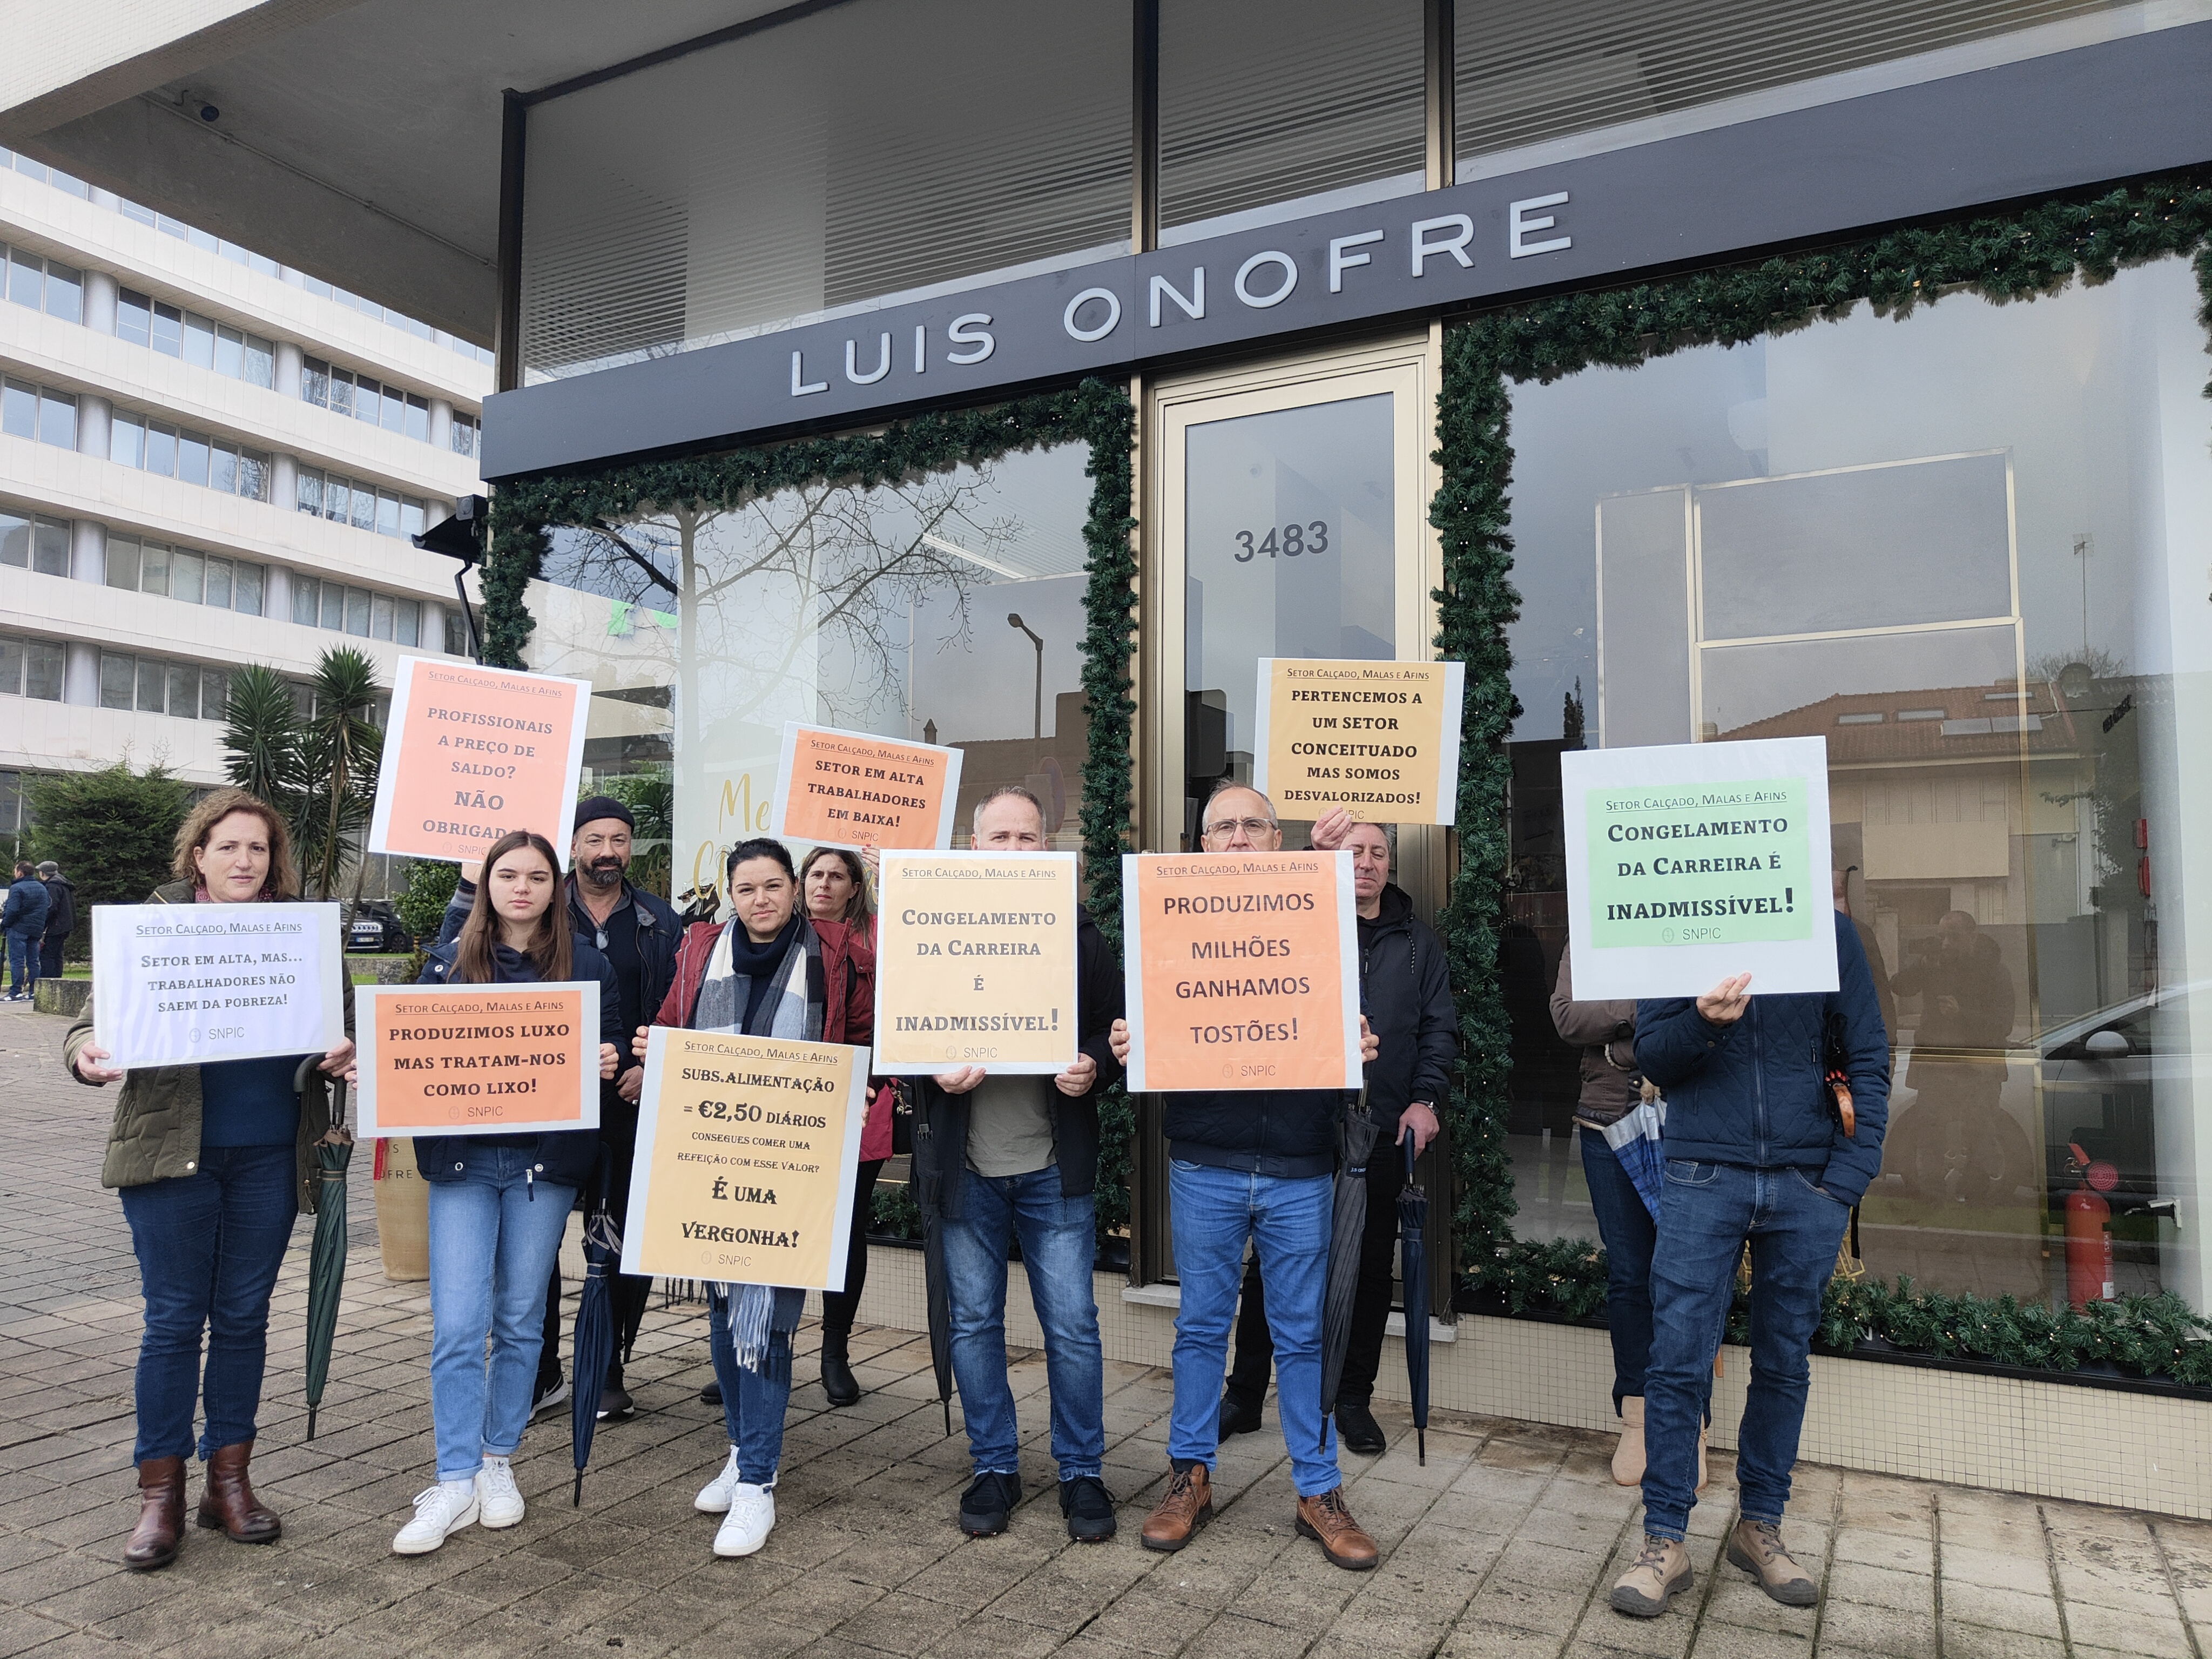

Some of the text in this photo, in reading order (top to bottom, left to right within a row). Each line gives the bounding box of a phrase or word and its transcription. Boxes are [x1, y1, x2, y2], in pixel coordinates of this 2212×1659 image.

[790, 191, 1573, 397] LUIS ONOFRE
[1235, 521, 1328, 563] 3483
[1292, 691, 1422, 704] PERTENCEMOS A
[428, 707, 552, 734] PROFISSIONAIS
[1313, 717, 1398, 730] UM SETOR
[438, 736, 535, 757] A PREÇO DE
[1291, 743, 1417, 757] CONCEITUADO
[451, 761, 516, 779] SALDO?
[815, 761, 925, 786] SETOR EM ALTA
[1307, 767, 1400, 780] MAS SOMOS
[454, 790, 504, 810] NÃO
[808, 783, 926, 809] TRABALHADORES
[1284, 790, 1420, 804] DESVALORIZADOS!
[827, 808, 900, 827] EM BAIXA!
[423, 820, 526, 839] OBRIGAD
[852, 831, 879, 841] SNPIC
[1769, 851, 1781, 869] É
[1164, 893, 1314, 914] PRODUZIMOS
[1608, 888, 1793, 920] INADMISSÍVEL!
[1683, 928, 1721, 940] SNPIC
[1192, 935, 1290, 959] MILHÕES
[195, 955, 214, 965] EM
[219, 954, 257, 966] ALTA,
[148, 974, 295, 990] TRABALHADORES NÃO
[973, 975, 984, 990] É
[1176, 977, 1310, 999] GANHAMOS
[158, 994, 287, 1012] SAEM DA POBREZA!
[896, 1008, 1058, 1031] INADMISSÍVEL!
[209, 1027, 244, 1040] SNPIC
[389, 1024, 569, 1041] PRODUZIMOS LUXO
[1190, 1018, 1298, 1044] TOSTÕES!
[394, 1053, 565, 1070] MAS TRATAM-NOS
[964, 1047, 997, 1058] SNPIC
[1241, 1065, 1276, 1076] SNPIC
[424, 1078, 536, 1096] COMO LIXO!
[468, 1106, 503, 1117] SNPIC
[699, 1100, 762, 1122] €2,50
[766, 1111, 826, 1128] DIÁRIOS
[692, 1132, 811, 1150] CONSEGUES COMER UMA
[677, 1152, 820, 1172] REFEIÇÃO COM ESSE VALOR?
[712, 1176, 777, 1204] É UMA
[681, 1221, 799, 1248] VERGONHA!
[718, 1254, 752, 1266] SNPIC
